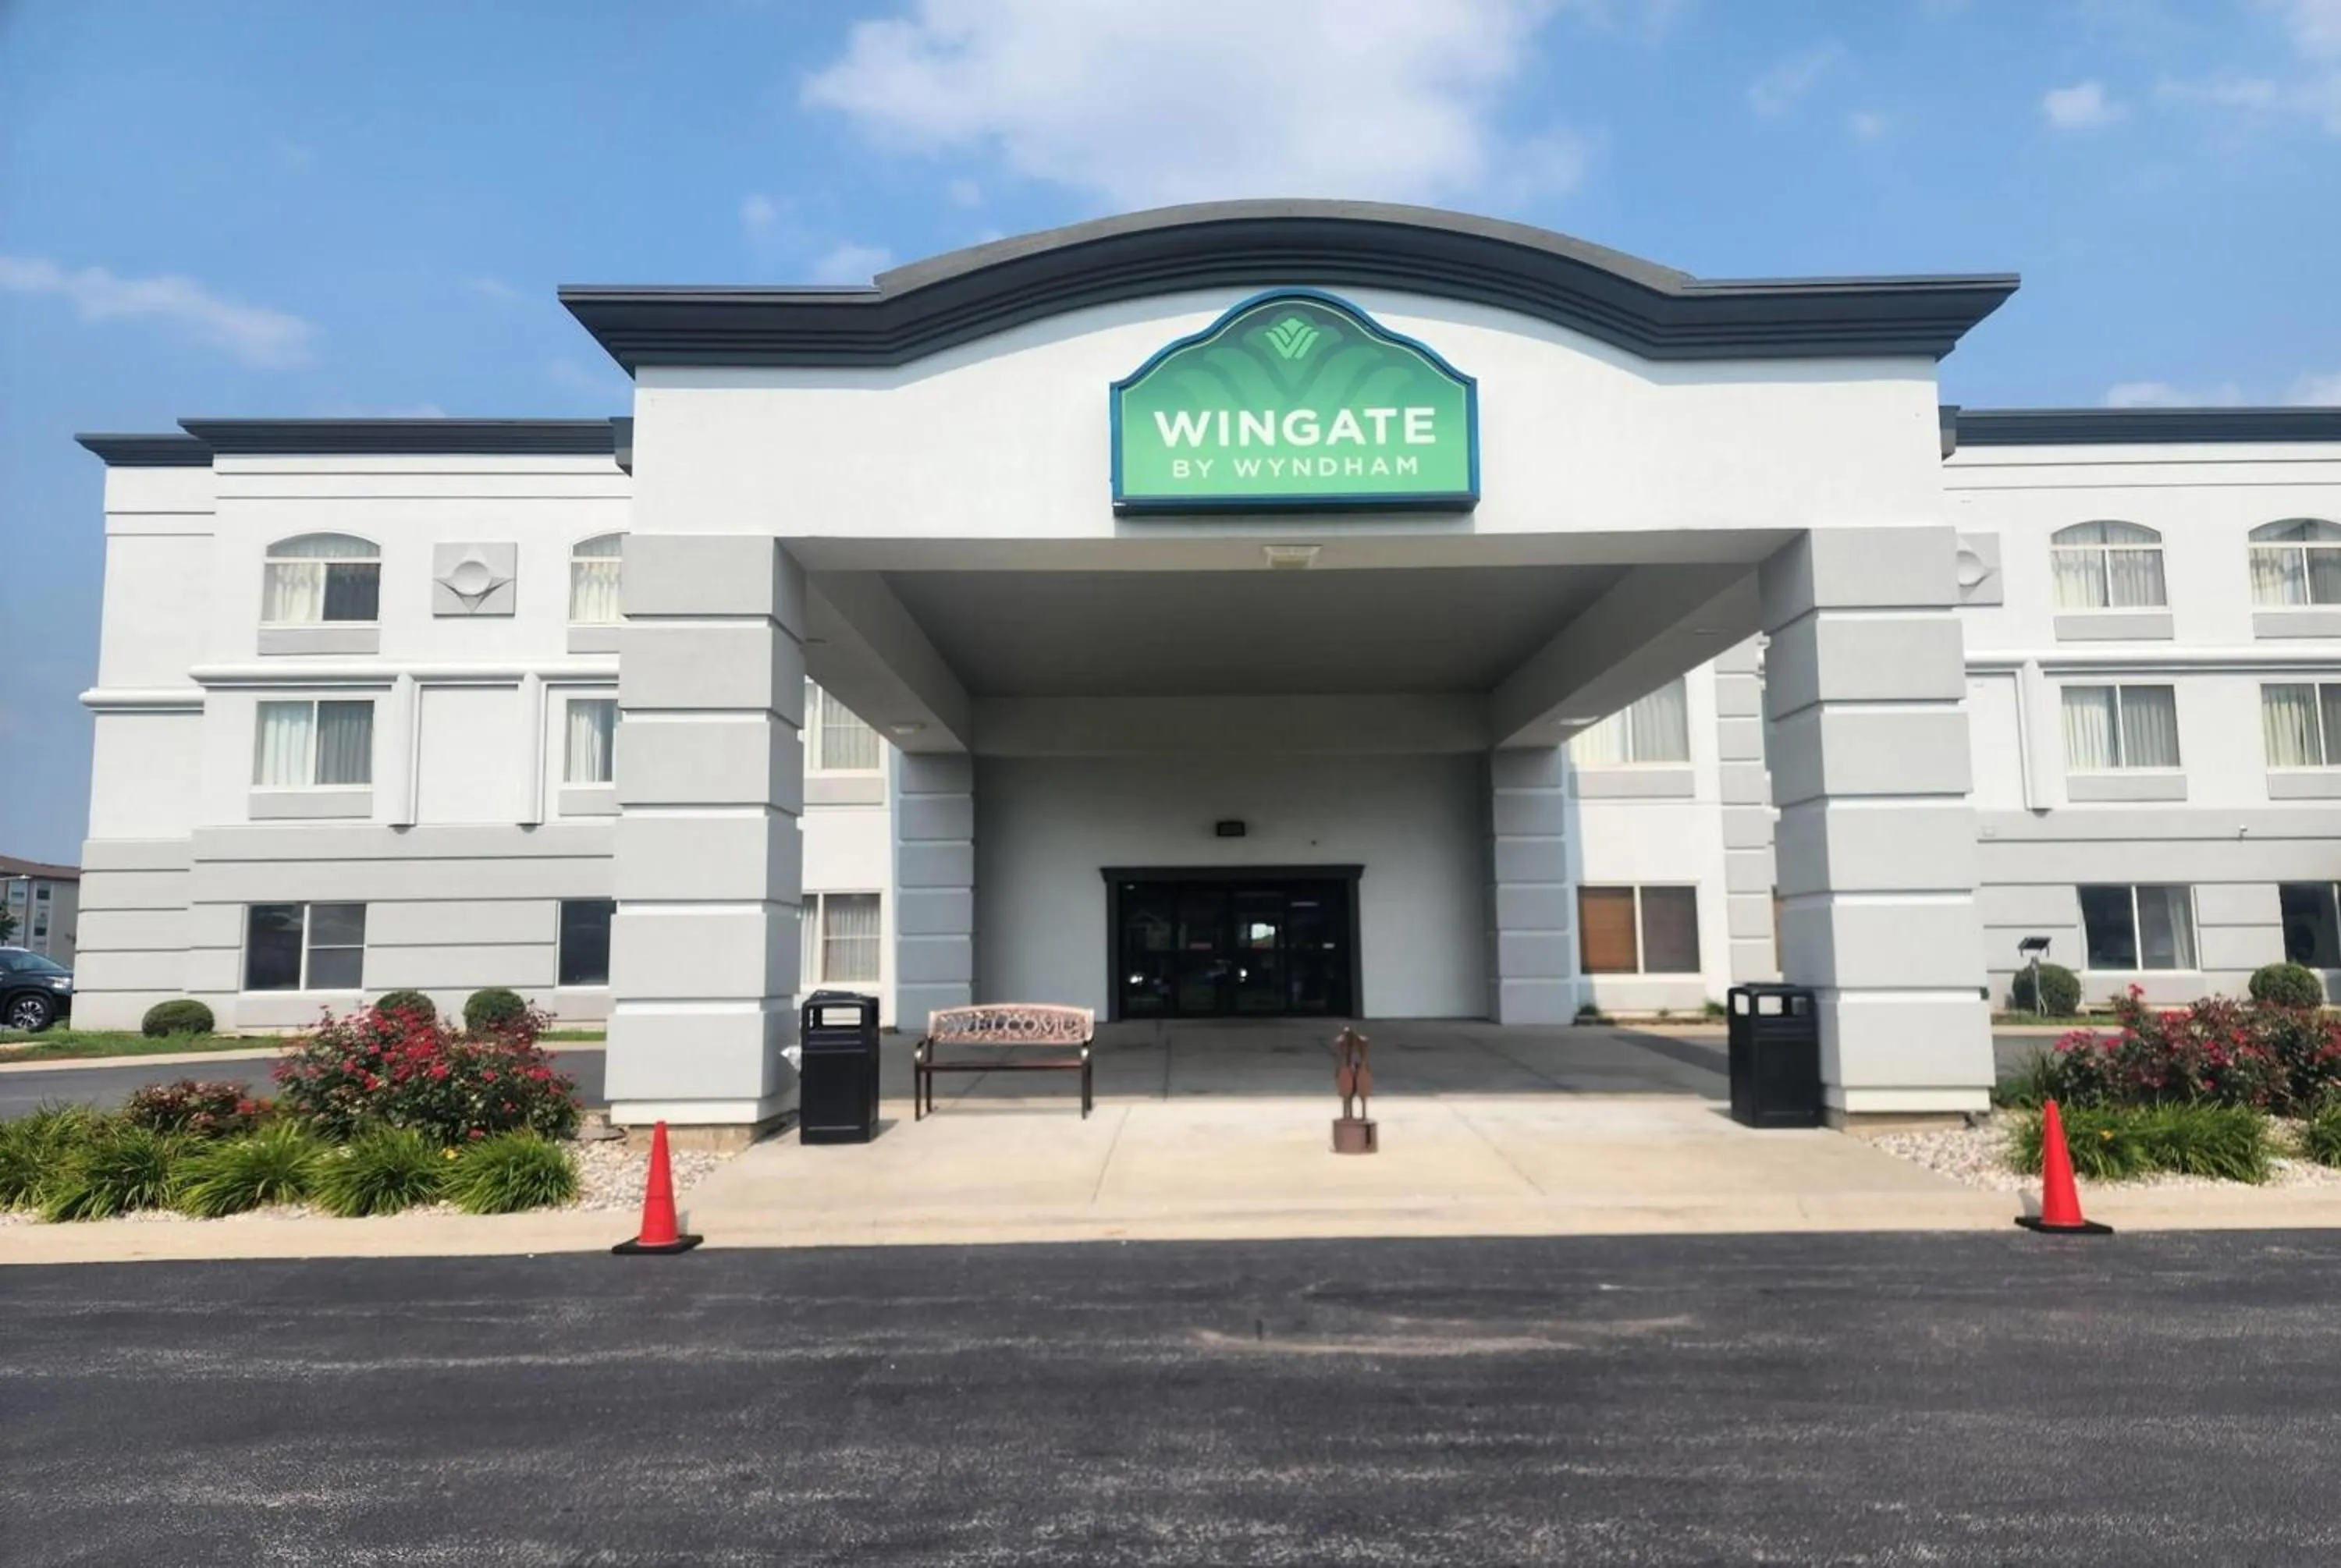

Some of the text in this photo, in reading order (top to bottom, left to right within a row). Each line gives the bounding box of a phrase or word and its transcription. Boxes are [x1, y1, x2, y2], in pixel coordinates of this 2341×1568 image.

[1153, 407, 1437, 447] WINGATE
[1172, 456, 1419, 478] BY WYNDHAM
